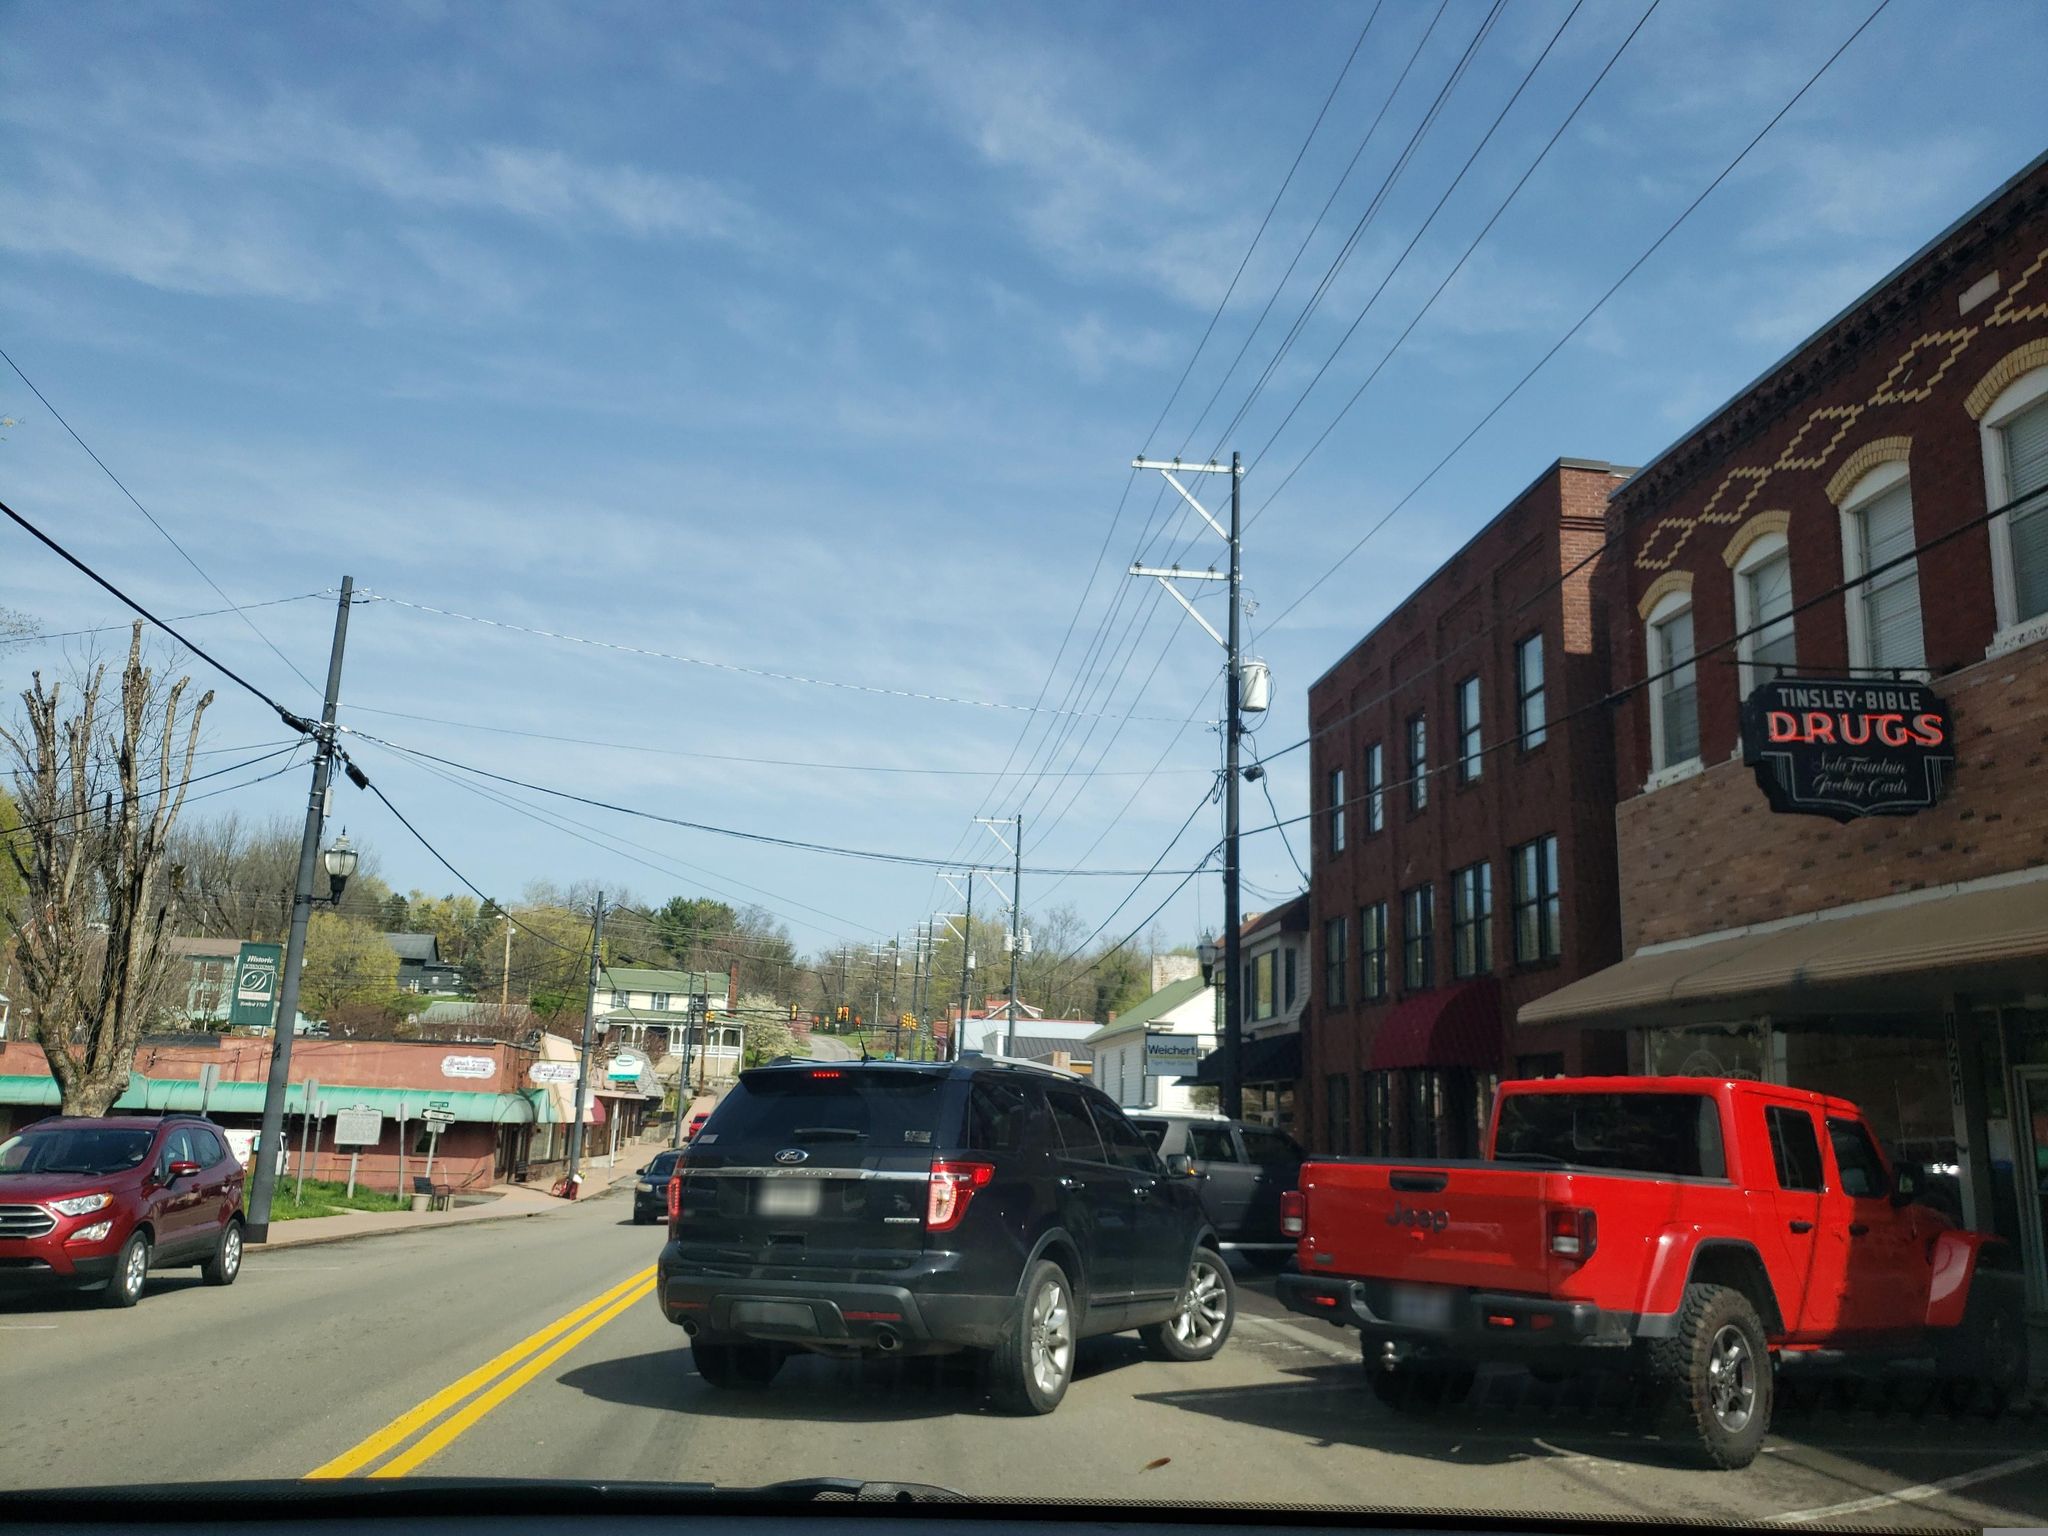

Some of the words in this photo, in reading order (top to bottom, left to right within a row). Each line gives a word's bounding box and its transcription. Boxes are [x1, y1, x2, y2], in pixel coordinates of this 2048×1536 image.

[1766, 711, 1944, 747] DRUGS
[1845, 756, 1906, 775] Fountain
[1812, 773, 1866, 798] Greeting
[1868, 778, 1908, 798] Cards
[247, 955, 274, 964] Historic
[1148, 1044, 1195, 1055] Weichert
[1386, 1201, 1448, 1233] Jeep
